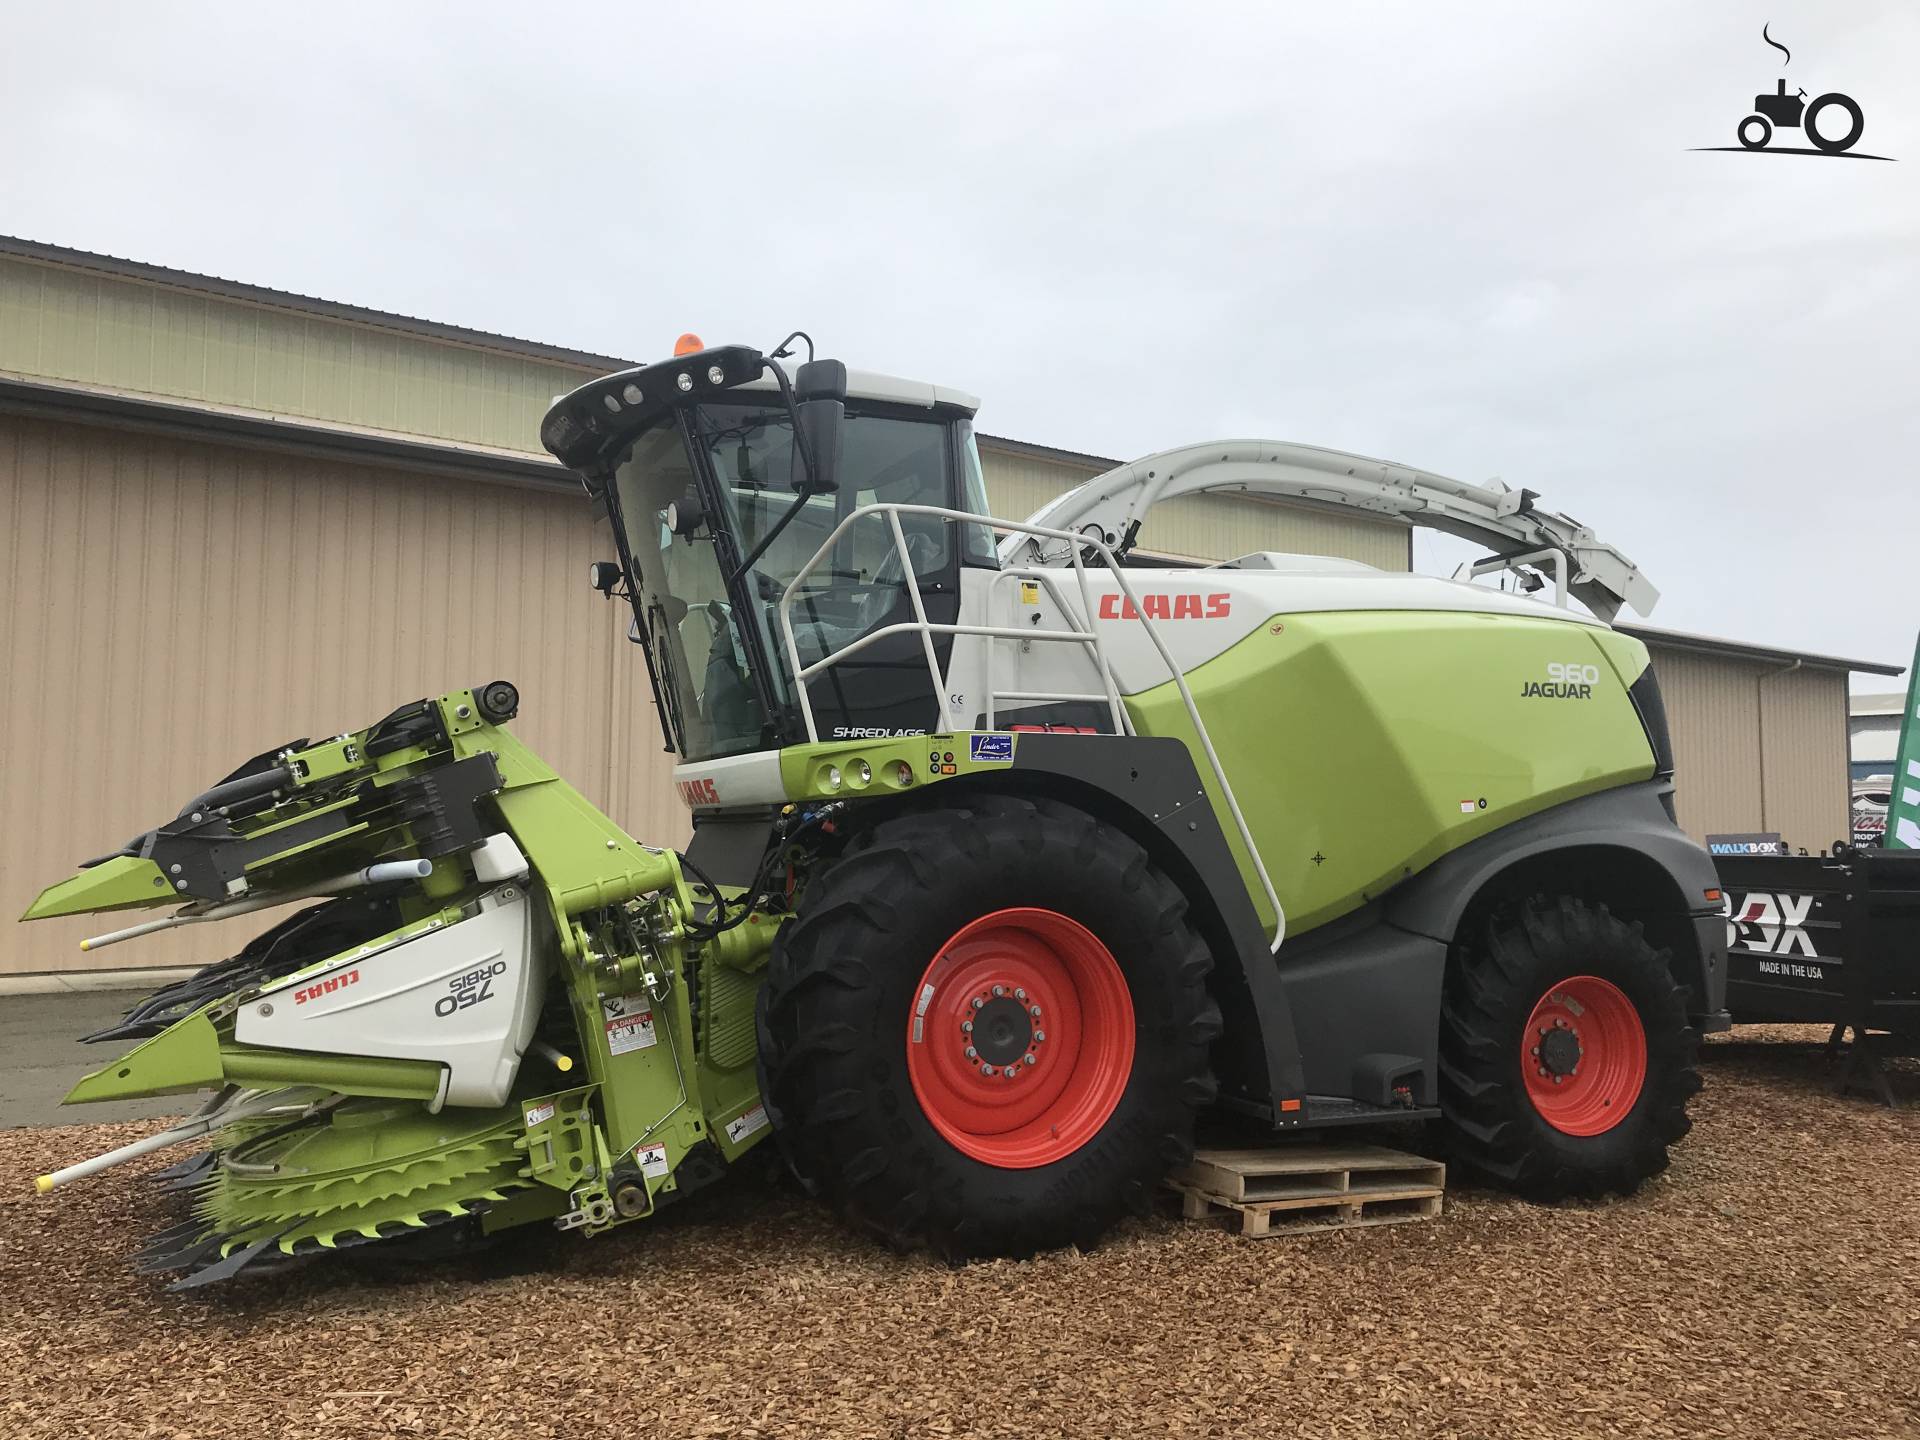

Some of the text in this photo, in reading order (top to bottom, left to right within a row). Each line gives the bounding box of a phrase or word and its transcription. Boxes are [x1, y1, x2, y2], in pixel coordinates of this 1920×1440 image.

[1099, 593, 1230, 619] CLAAS
[1547, 662, 1599, 685] 960
[1521, 682, 1591, 699] JAGUAR
[1711, 843, 1777, 853] WALKBOX
[449, 961, 507, 993] ORBIS
[1760, 961, 1823, 979] MADE IN THE USA
[294, 969, 360, 1005] CLAAS
[434, 979, 494, 1017] 750
[620, 1015, 648, 1027] DANGER
